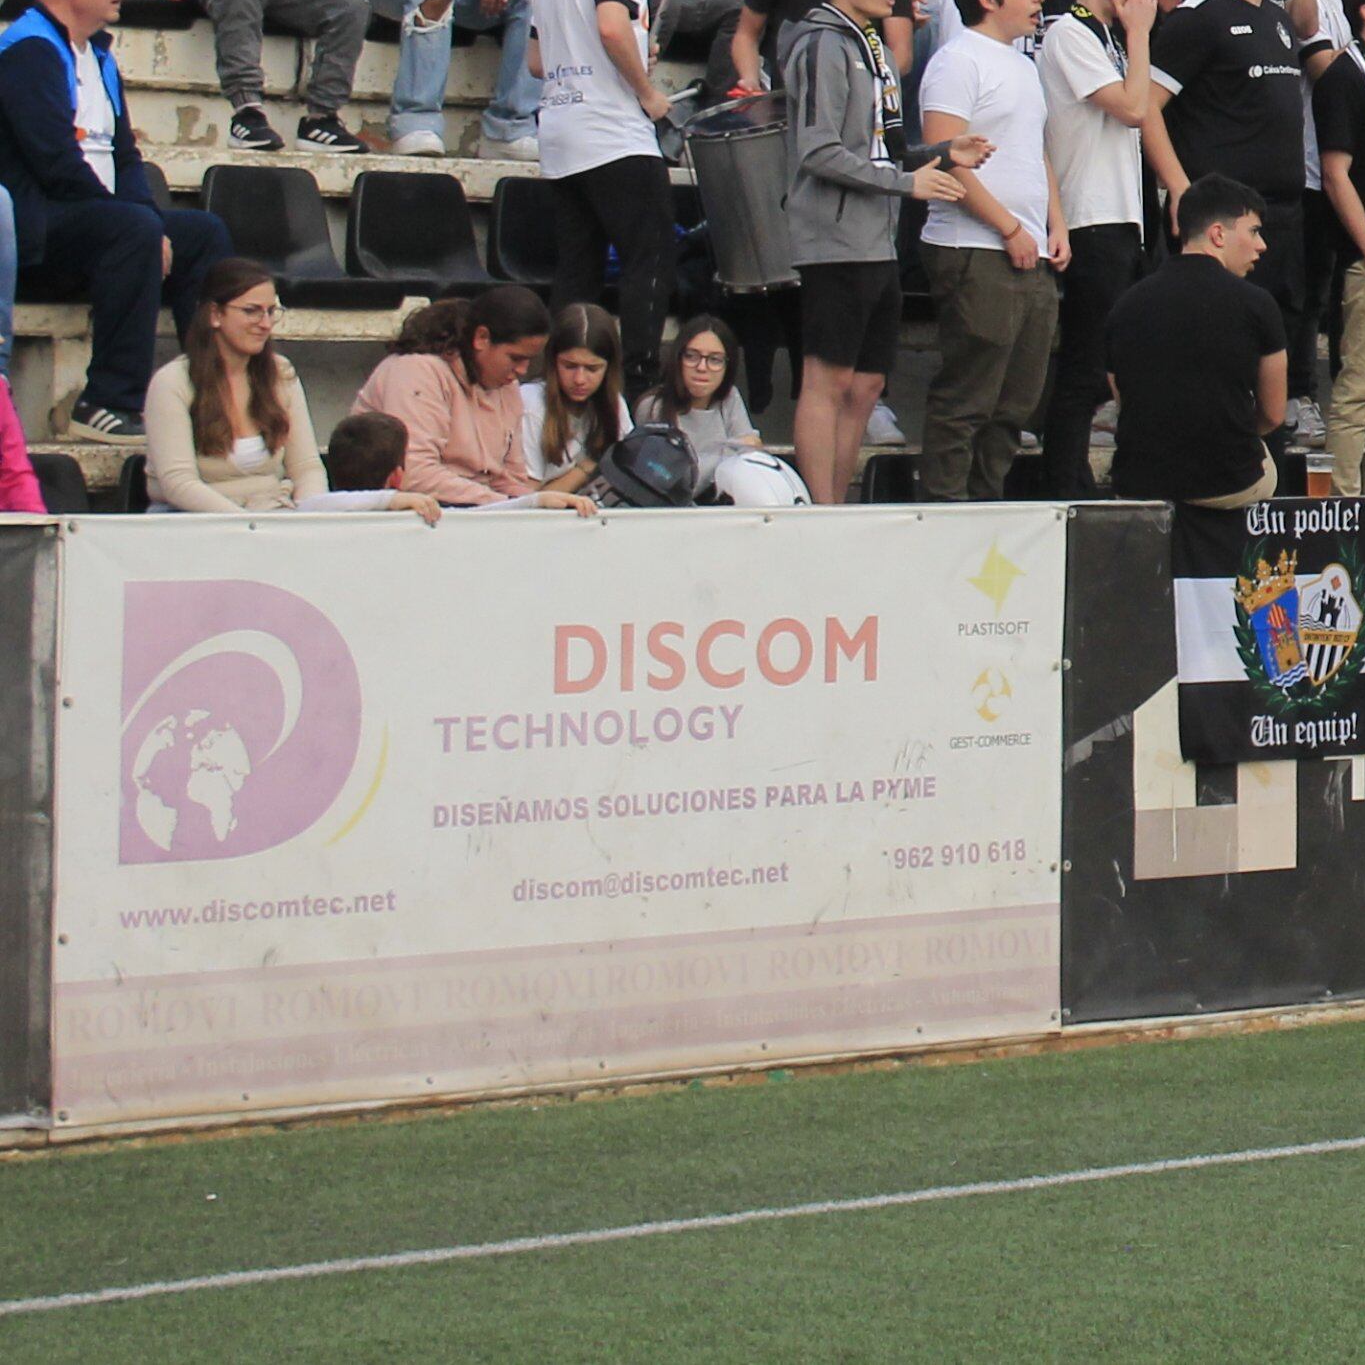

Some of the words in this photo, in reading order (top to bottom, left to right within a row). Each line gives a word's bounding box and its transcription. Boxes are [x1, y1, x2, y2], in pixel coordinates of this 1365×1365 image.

[1247, 502, 1286, 536] Un
[1294, 500, 1362, 539] poble!
[958, 620, 1030, 636] PLASTISOFT
[553, 615, 879, 694] DISCOM
[433, 704, 744, 753] TECHNOLOGY
[950, 733, 1032, 750] GEST-COMMERCE
[1250, 715, 1287, 747] Un
[1294, 711, 1358, 748] equip!
[433, 796, 589, 829] DISEÑAMOS
[597, 786, 757, 819] SOLUCIONES
[765, 783, 828, 809] PARA
[836, 780, 865, 803] LA
[872, 776, 937, 800] PYME
[894, 845, 933, 870] 962
[942, 843, 981, 866] 910
[987, 839, 1026, 863] 618
[512, 863, 789, 902] discom@discomtec.net
[120, 890, 397, 929] www.discomtec.net
